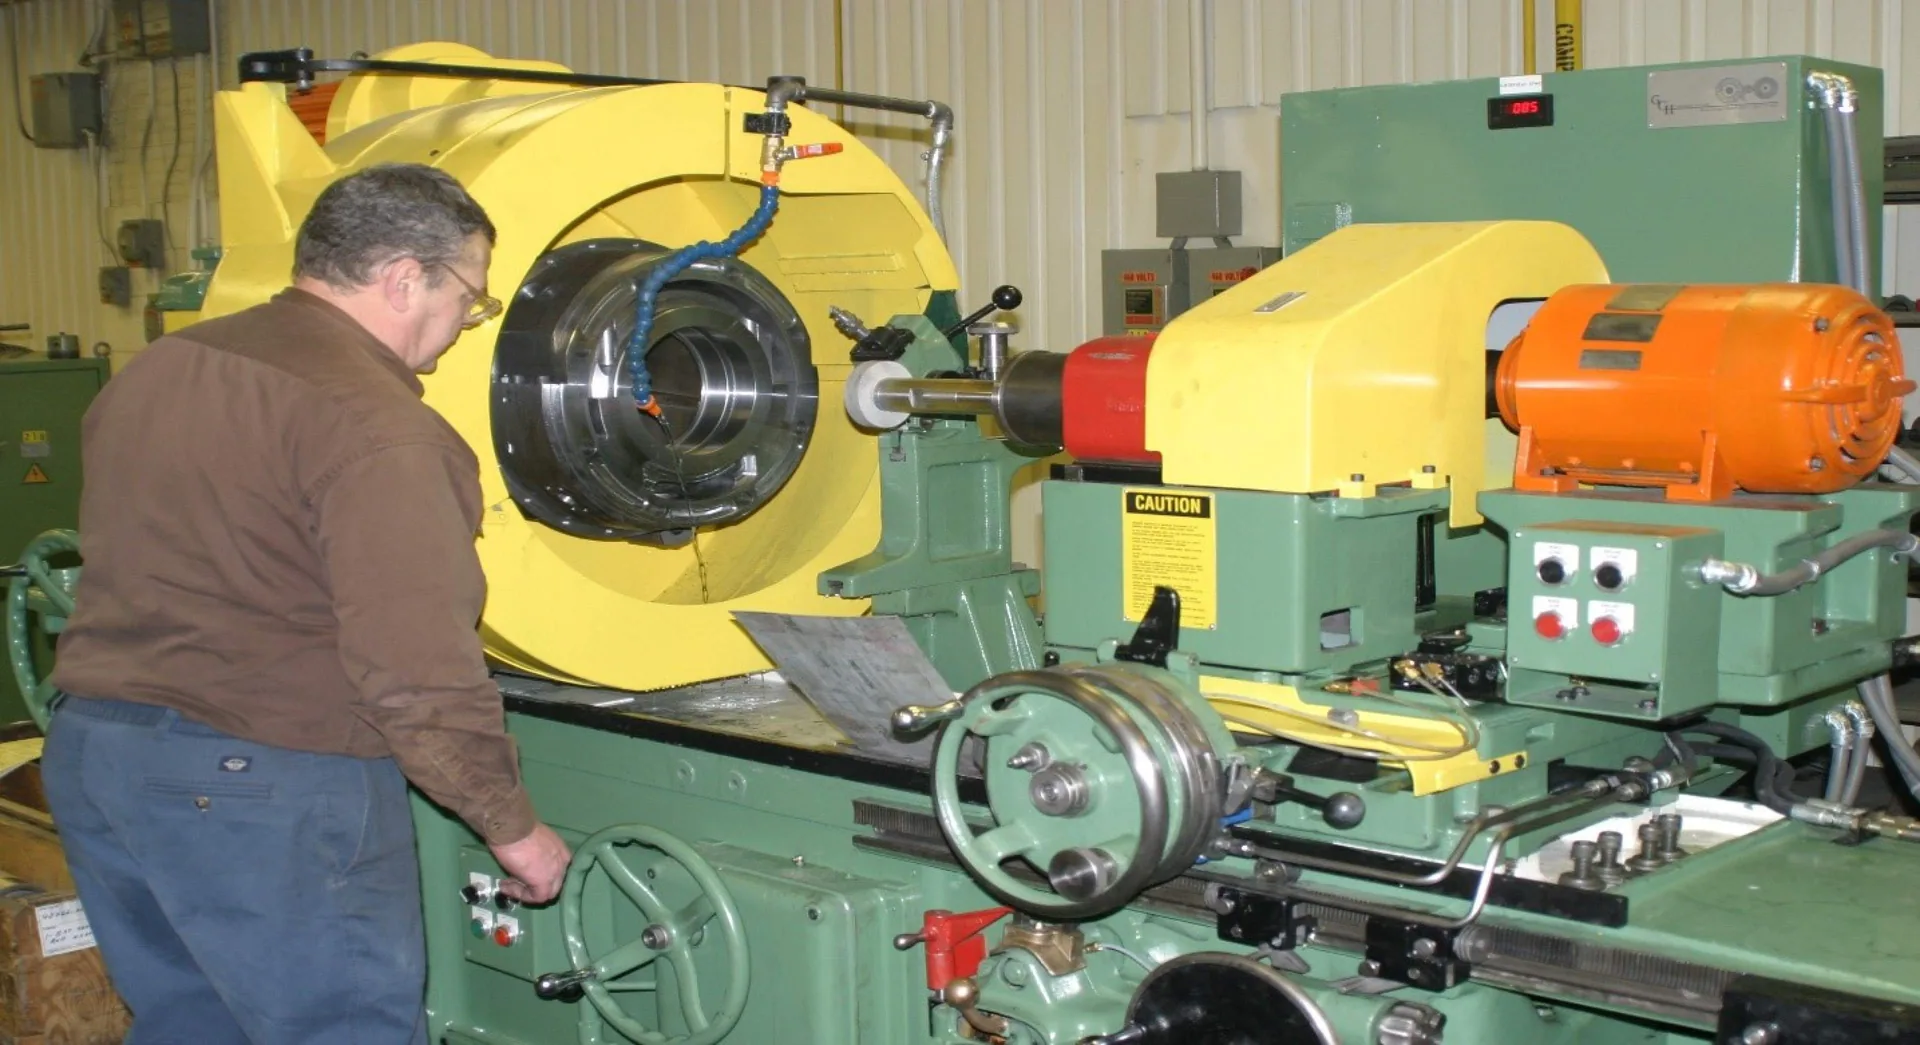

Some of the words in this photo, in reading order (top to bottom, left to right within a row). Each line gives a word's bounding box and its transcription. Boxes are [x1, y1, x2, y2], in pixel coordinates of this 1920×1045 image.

[1511, 101, 1538, 114] 085
[1136, 272, 1155, 282] VOLTS
[1135, 495, 1201, 514] CAUTION
